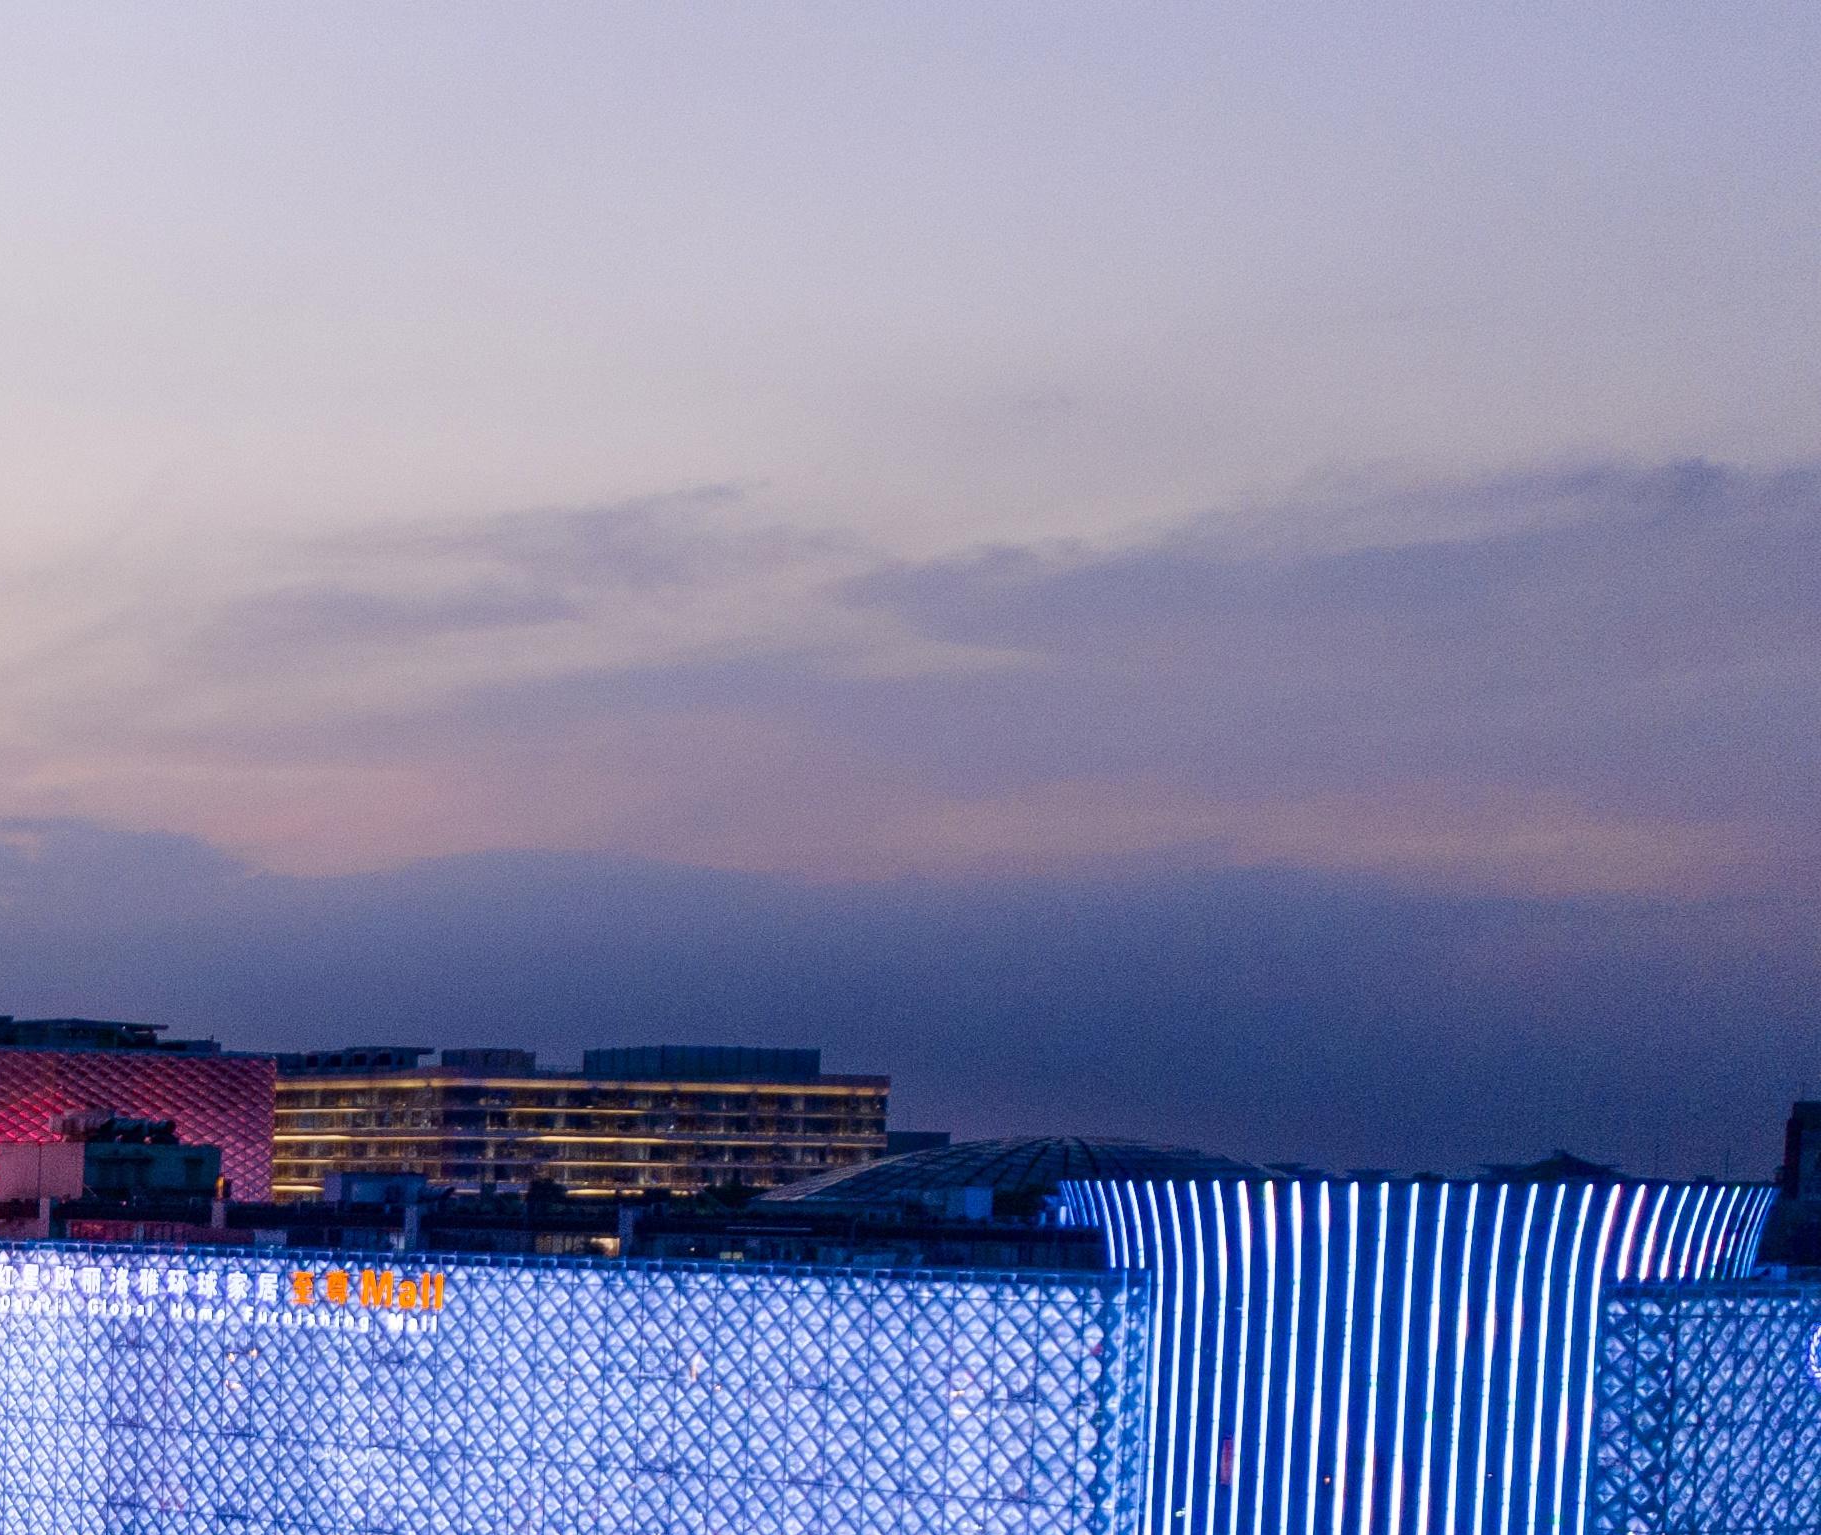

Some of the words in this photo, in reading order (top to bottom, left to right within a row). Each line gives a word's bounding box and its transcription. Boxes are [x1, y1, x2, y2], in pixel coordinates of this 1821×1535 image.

[88, 1298, 154, 1318] Global
[170, 1302, 226, 1321] Home
[242, 1306, 370, 1333] Furnishing
[387, 1312, 439, 1332] Mall
